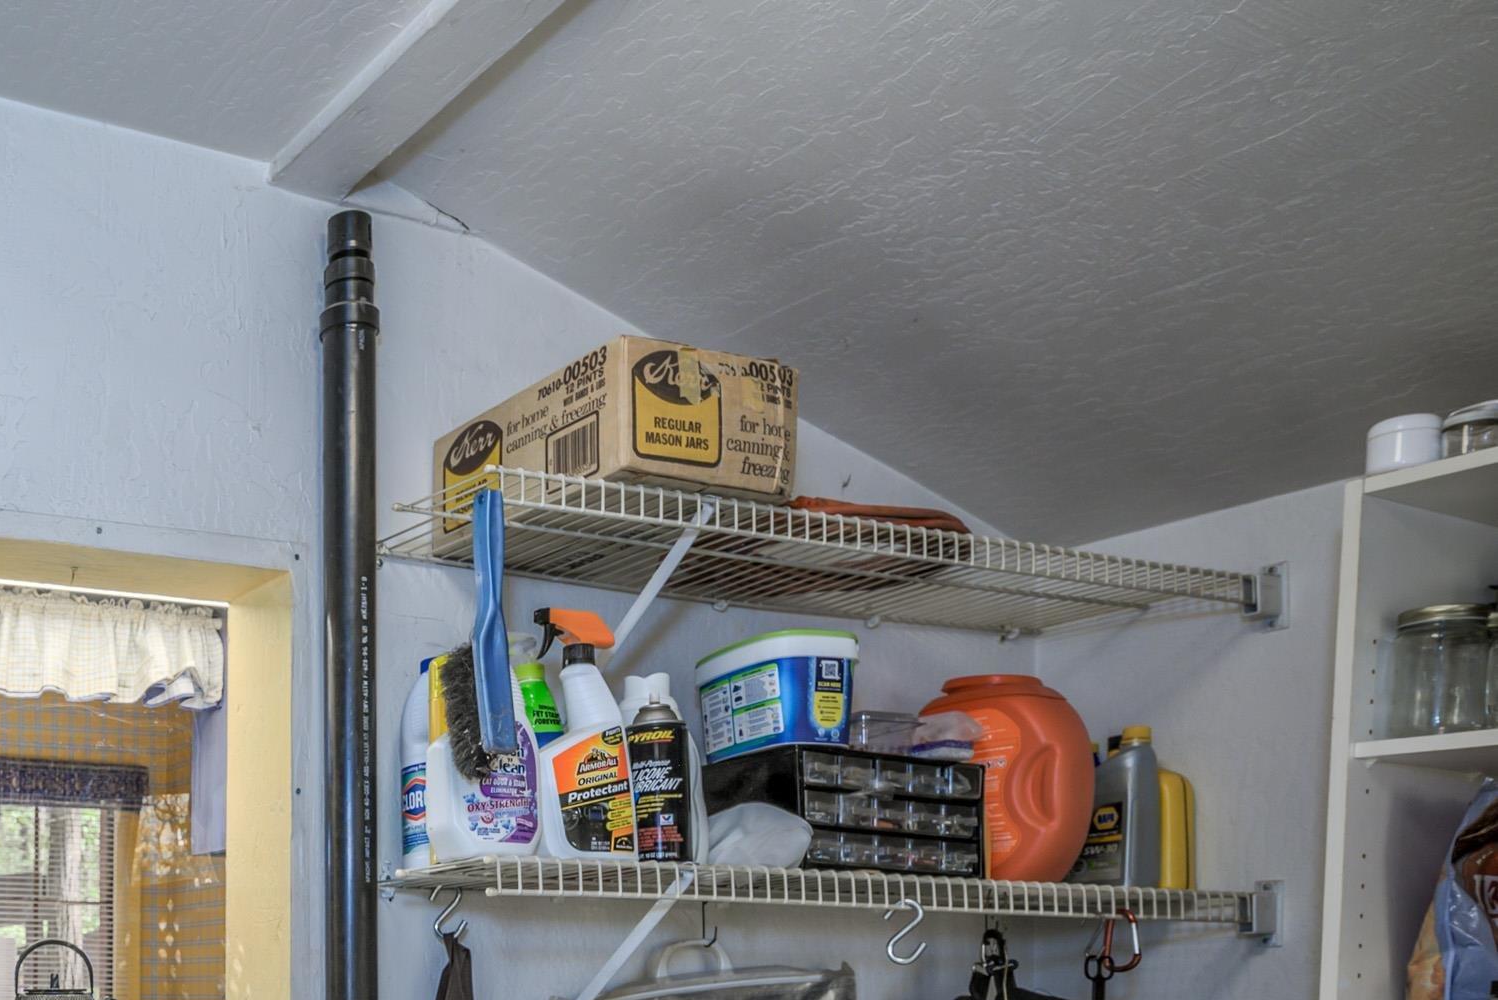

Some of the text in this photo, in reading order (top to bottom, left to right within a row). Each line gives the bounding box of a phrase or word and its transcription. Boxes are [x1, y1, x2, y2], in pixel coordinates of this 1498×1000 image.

[576, 367, 604, 389] PINTS
[506, 405, 549, 436] for home
[506, 392, 607, 453] canning & freezing
[654, 417, 702, 434] REGULAR
[740, 415, 759, 432] for
[450, 423, 495, 468] Kerr
[645, 431, 709, 450] MASON JARS
[628, 730, 675, 743] PYROIL
[578, 771, 618, 786] ORIGINAL
[568, 781, 628, 803] Protectant
